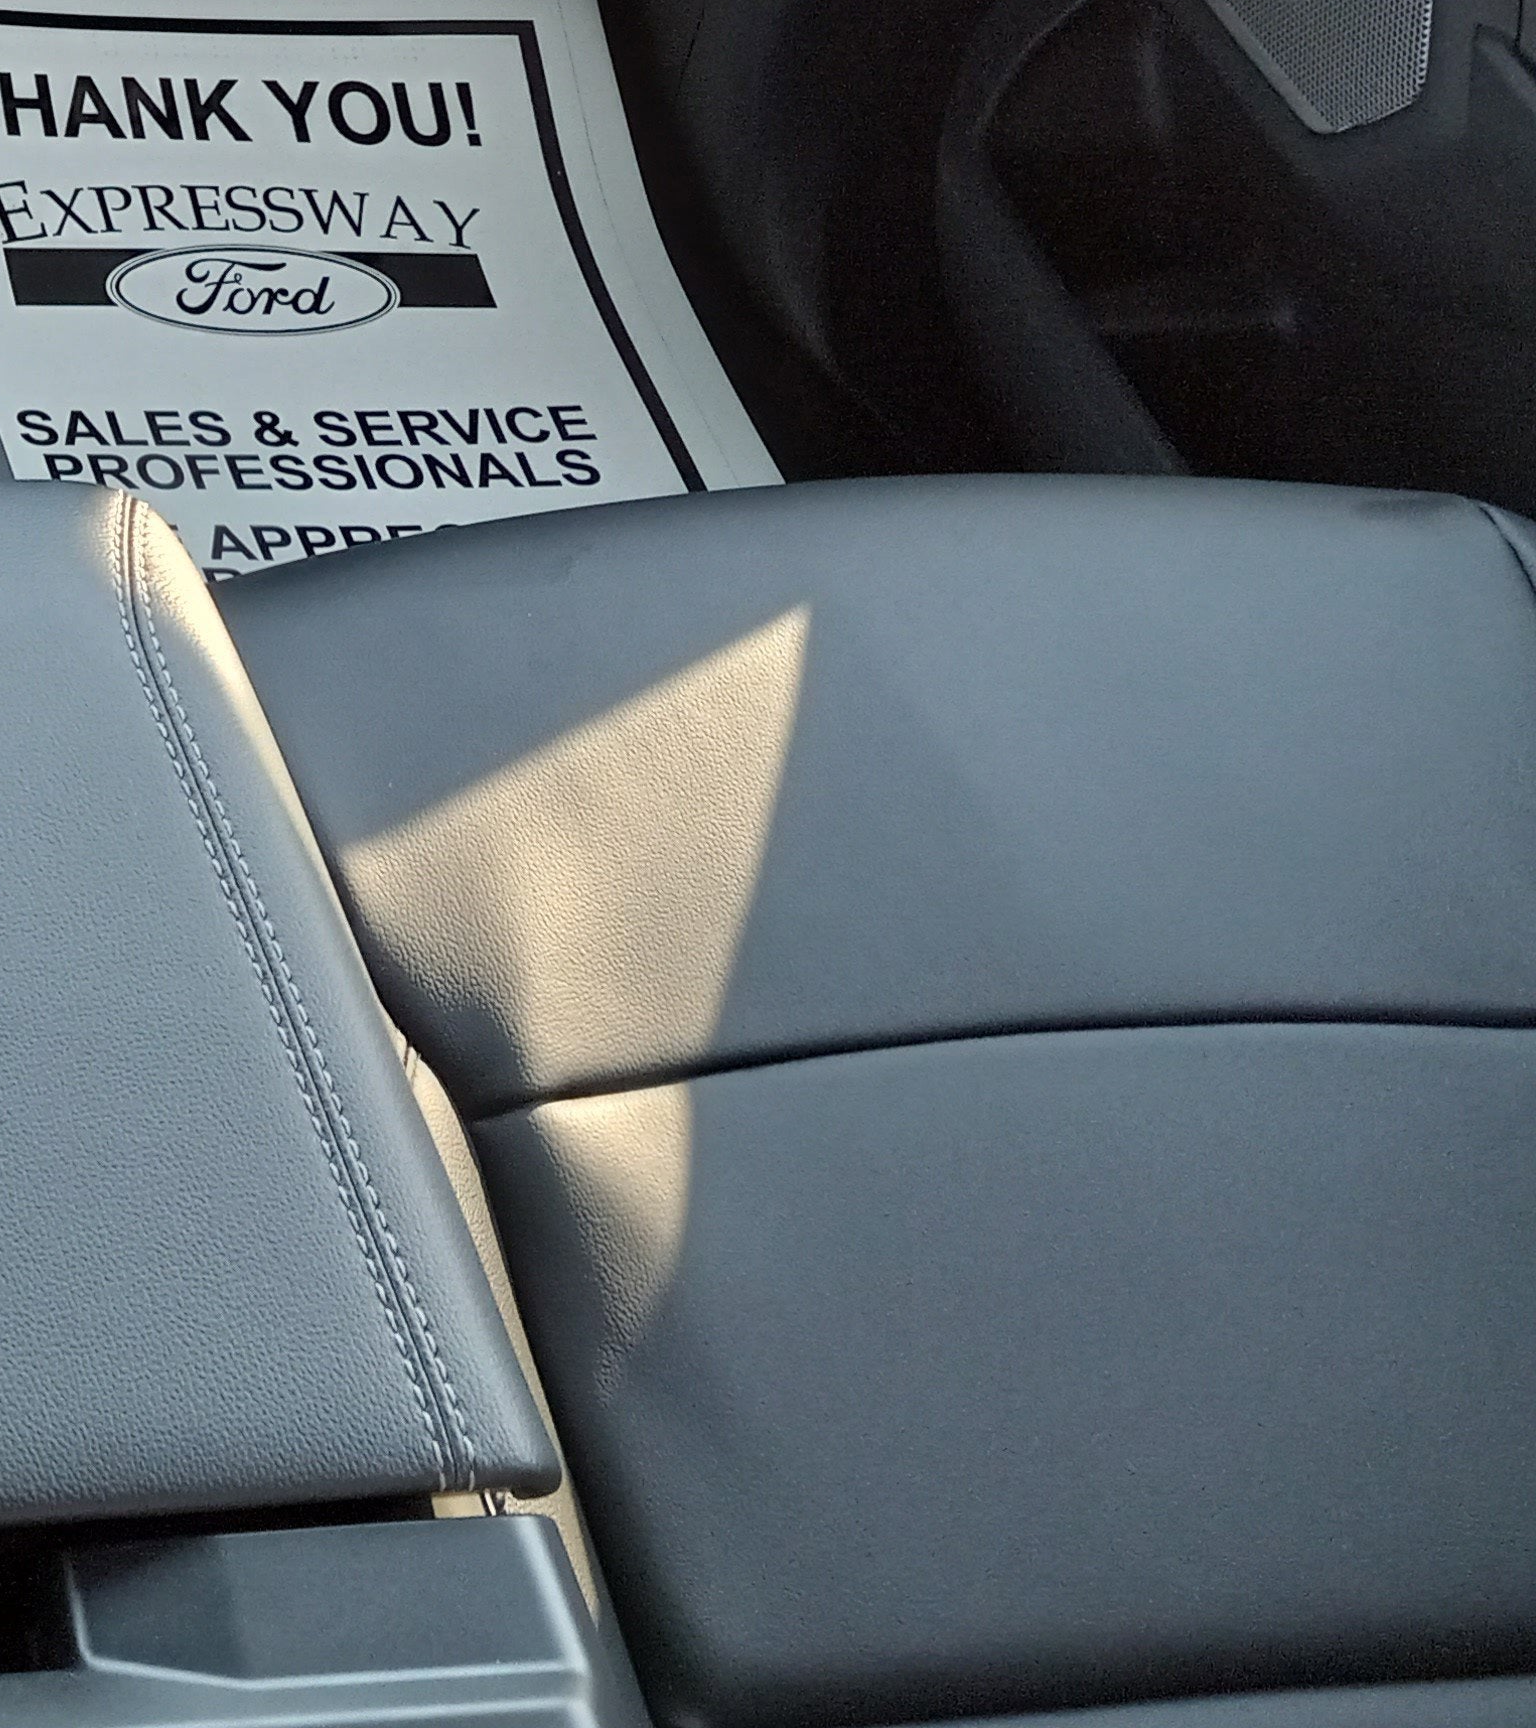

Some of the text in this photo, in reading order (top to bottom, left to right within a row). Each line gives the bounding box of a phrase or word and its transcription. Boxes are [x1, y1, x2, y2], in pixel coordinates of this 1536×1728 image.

[261, 78, 483, 149] YOU!
[174, 257, 336, 320] Ford
[15, 403, 599, 449] SALES & SERVICE
[41, 447, 603, 492] PROFESSIONALS
